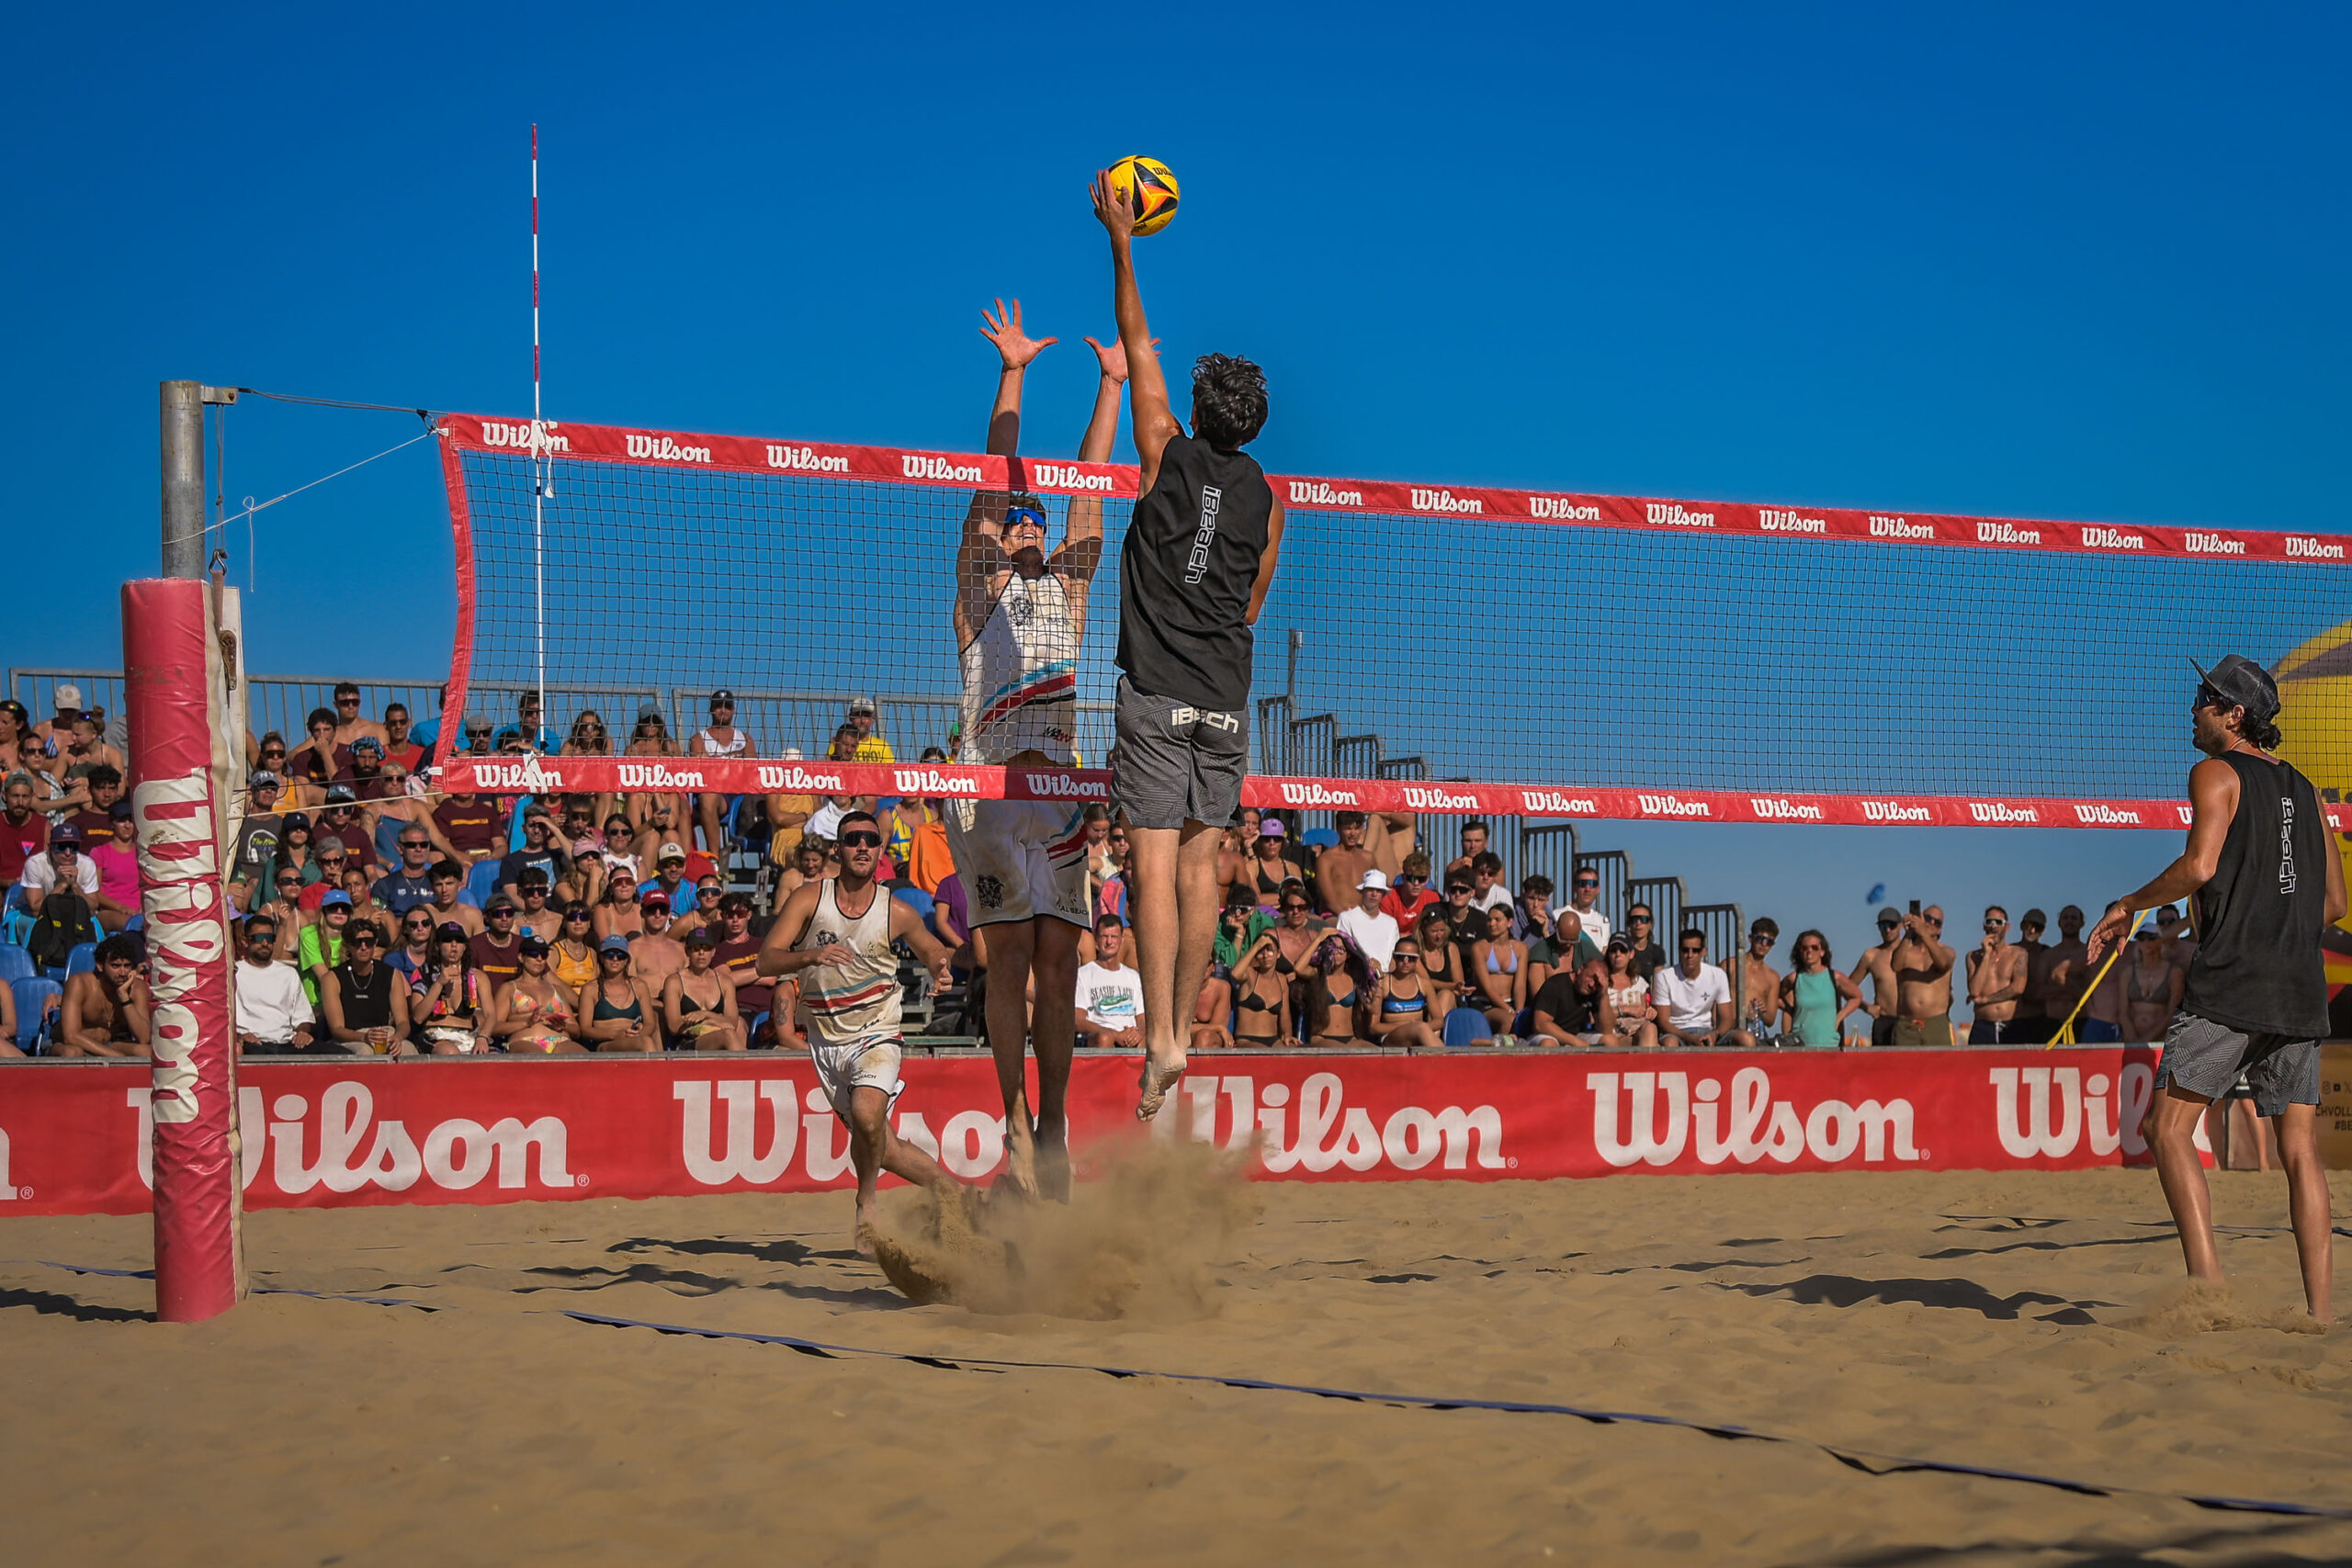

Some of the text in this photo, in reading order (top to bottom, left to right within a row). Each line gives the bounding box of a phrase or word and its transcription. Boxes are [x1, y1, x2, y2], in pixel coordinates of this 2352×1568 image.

[627, 435, 710, 462] Wilson
[766, 446, 848, 471] Wilson
[902, 456, 981, 481] Wilson
[1035, 465, 1114, 491] Wilson
[1290, 482, 1362, 506] Wilson
[1411, 490, 1482, 513] Wilson
[1530, 498, 1600, 521] Wilson
[1646, 504, 1713, 527] Wilson
[1759, 511, 1825, 533] Wilson
[1870, 517, 1933, 538] Wilson
[1185, 485, 1222, 583] iBeach
[1977, 523, 2040, 544] Wilson
[2083, 528, 2143, 549] Wilson
[2186, 534, 2245, 554] Wilson
[2286, 538, 2343, 558] Wilson
[618, 764, 704, 787] Wilson
[758, 767, 842, 790] Wilson
[894, 771, 977, 793] Wilson
[1026, 773, 1110, 796] Wilson
[1281, 784, 1357, 806] Wilson
[1403, 788, 1478, 809] Wilson
[1522, 792, 1595, 813] Wilson
[1638, 795, 1710, 817] Wilson
[1751, 799, 1821, 819] Wilson
[1862, 802, 1930, 821] Wilson
[1970, 803, 2037, 822] Wilson
[2075, 806, 2140, 824] Wilson
[133, 768, 223, 1122] Wilson
[1587, 1067, 1919, 1166] Wilson
